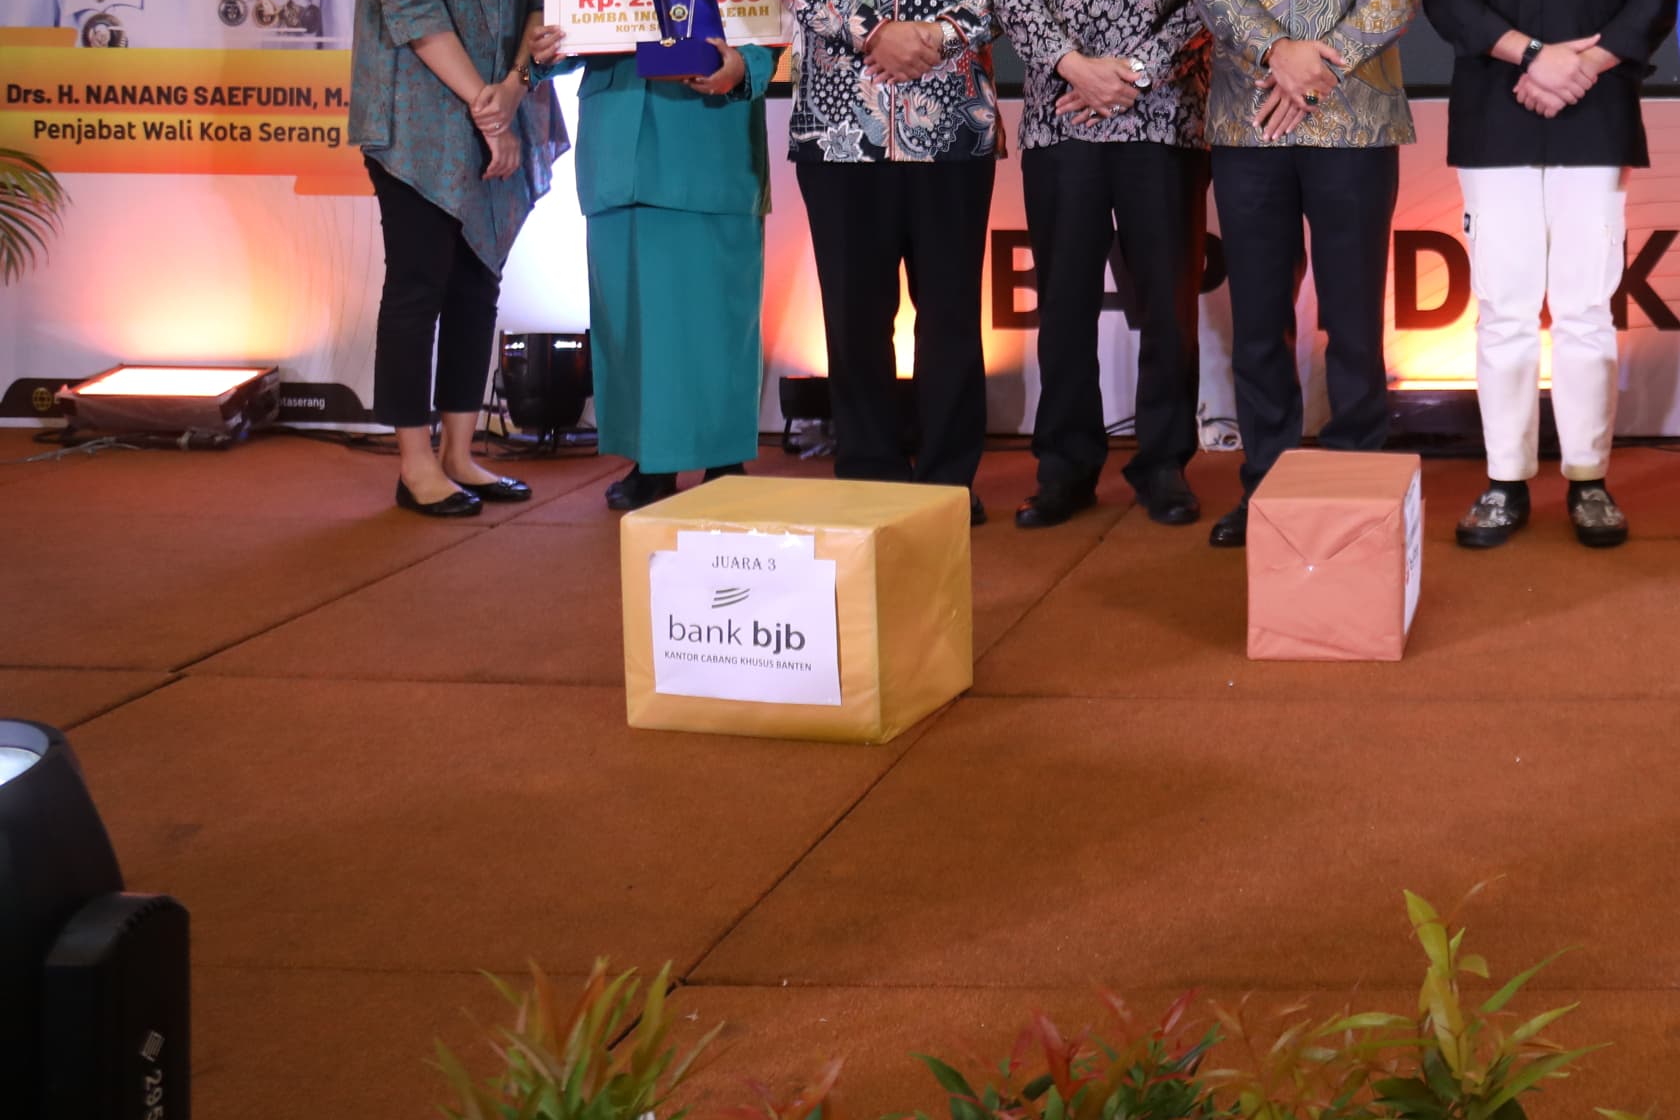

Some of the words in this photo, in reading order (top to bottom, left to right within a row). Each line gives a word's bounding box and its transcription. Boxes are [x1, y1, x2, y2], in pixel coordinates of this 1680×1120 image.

[572, 12, 629, 25] LOMBA
[720, 6, 770, 19] AERAH
[616, 24, 645, 33] KOTA
[7, 84, 51, 105] Drs.
[58, 85, 80, 105] H.
[86, 85, 188, 106] NANANG
[194, 86, 317, 109] SAEFUDIN,
[34, 119, 136, 145] Penjabat
[143, 119, 192, 141] Wali
[200, 121, 251, 142] Kota
[259, 123, 341, 147] Serang
[711, 554, 762, 570] JUARA
[768, 557, 777, 572] 3
[669, 614, 742, 646] bank
[752, 620, 806, 655] bjb
[664, 651, 699, 663] KANTOR
[700, 653, 738, 666] CABANG
[740, 657, 774, 669] KHUSUS
[775, 660, 812, 672] BANTEN
